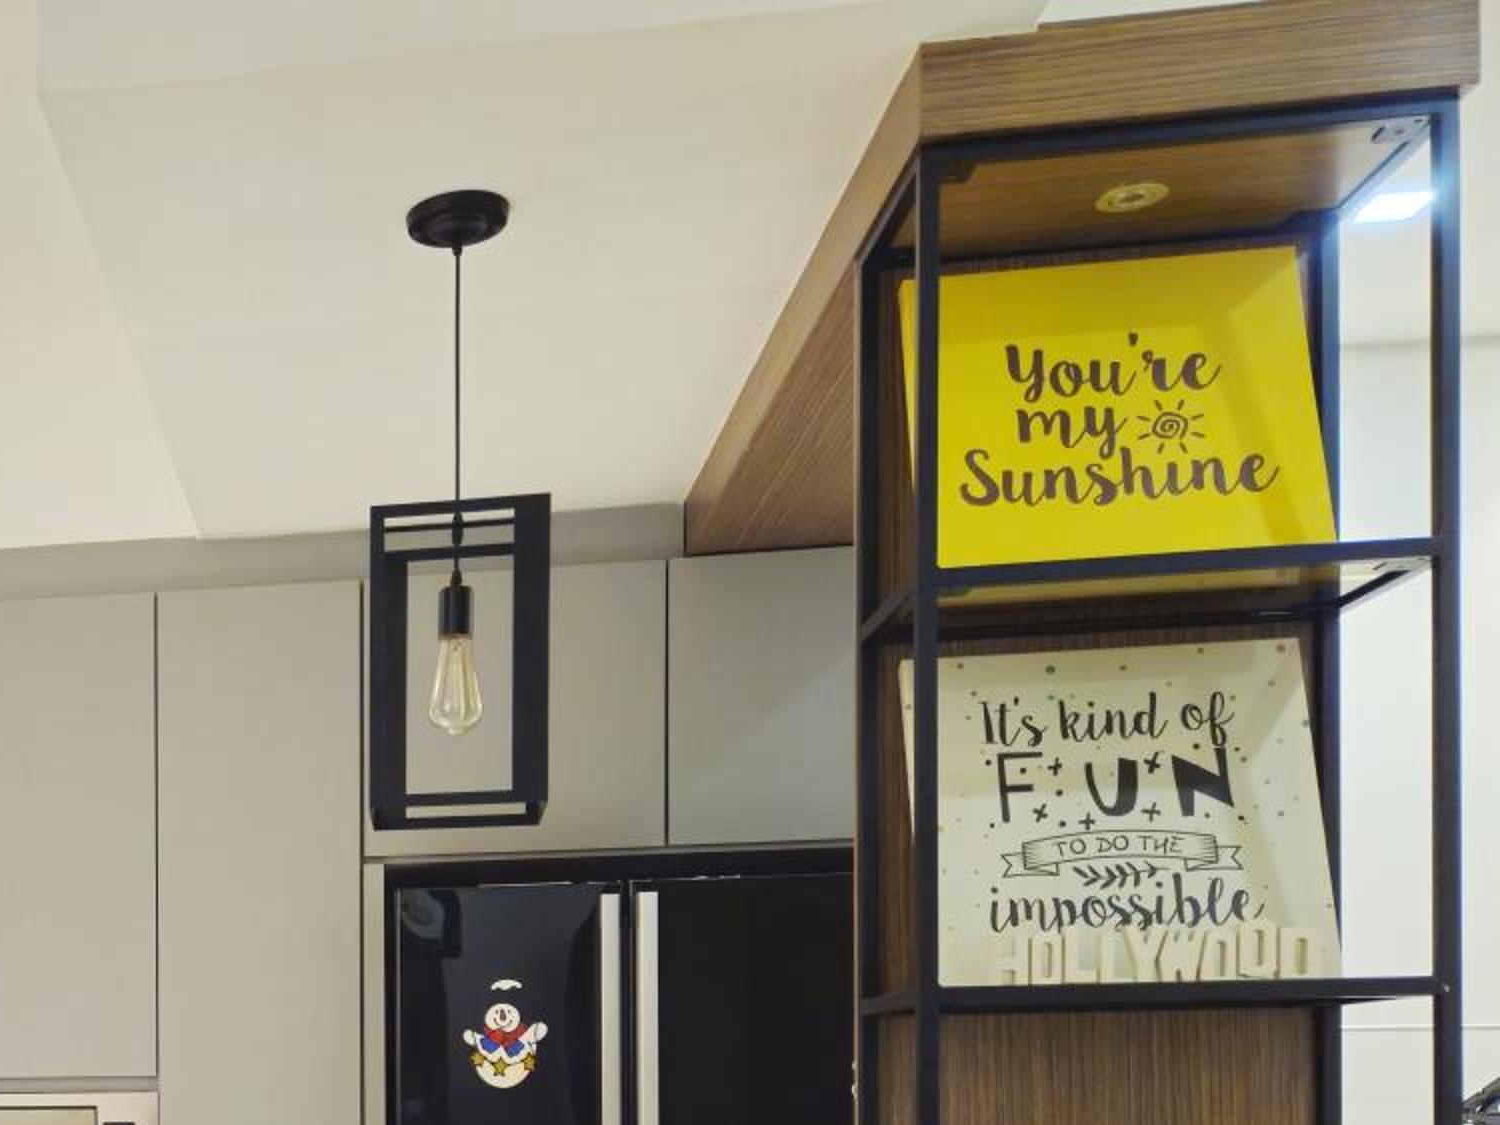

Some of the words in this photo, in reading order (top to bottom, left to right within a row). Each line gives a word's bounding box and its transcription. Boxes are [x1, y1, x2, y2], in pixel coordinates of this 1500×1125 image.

[1005, 332, 1222, 403] You're
[1016, 406, 1128, 458] my
[959, 447, 1280, 507] Sunshine
[978, 697, 1048, 746] It's
[1058, 691, 1168, 743] kind
[1180, 690, 1235, 748] of
[1052, 836, 1088, 855] TO
[1096, 834, 1130, 853] DO
[1140, 835, 1185, 854] THE
[1000, 921, 1320, 984] HOLLYWOOD
